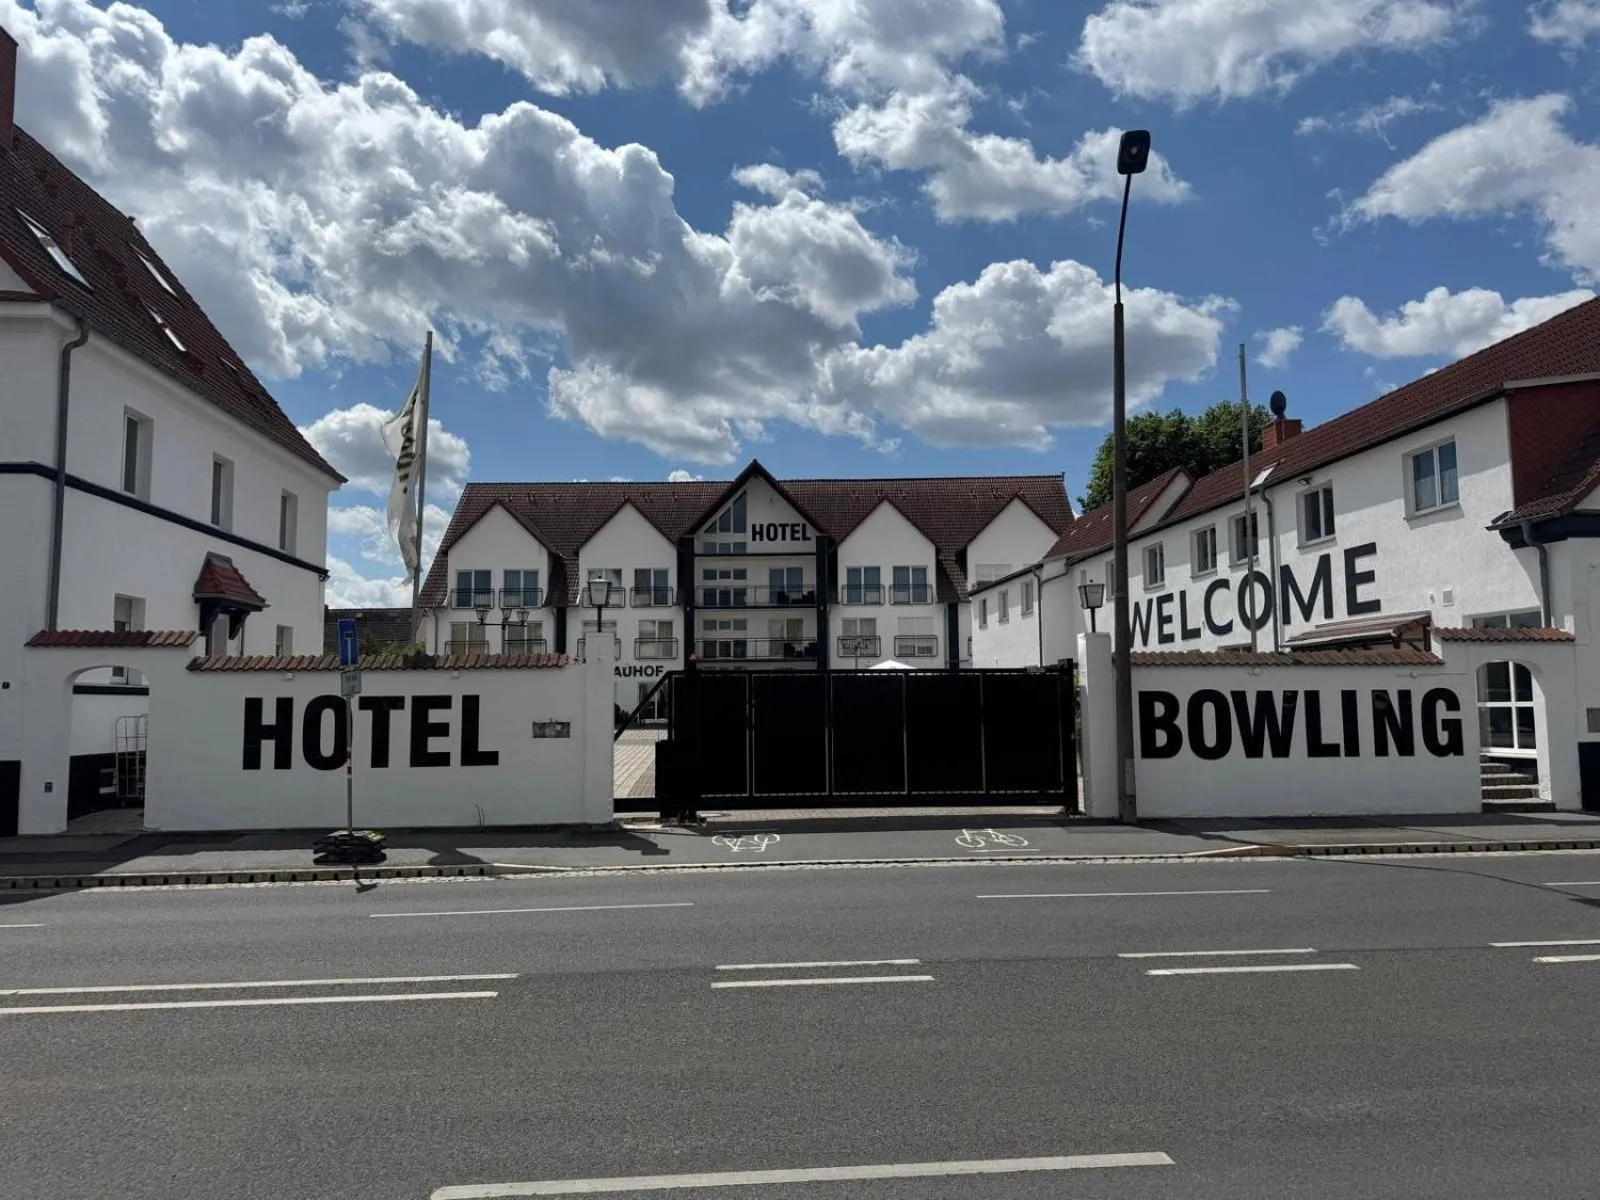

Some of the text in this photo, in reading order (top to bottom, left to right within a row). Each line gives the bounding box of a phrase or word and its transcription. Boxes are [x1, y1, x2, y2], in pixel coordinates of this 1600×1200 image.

[751, 523, 811, 542] HOTEL
[1128, 542, 1382, 649] WELCOME
[242, 694, 500, 771] HOTEL
[1137, 687, 1465, 761] BOWLING
